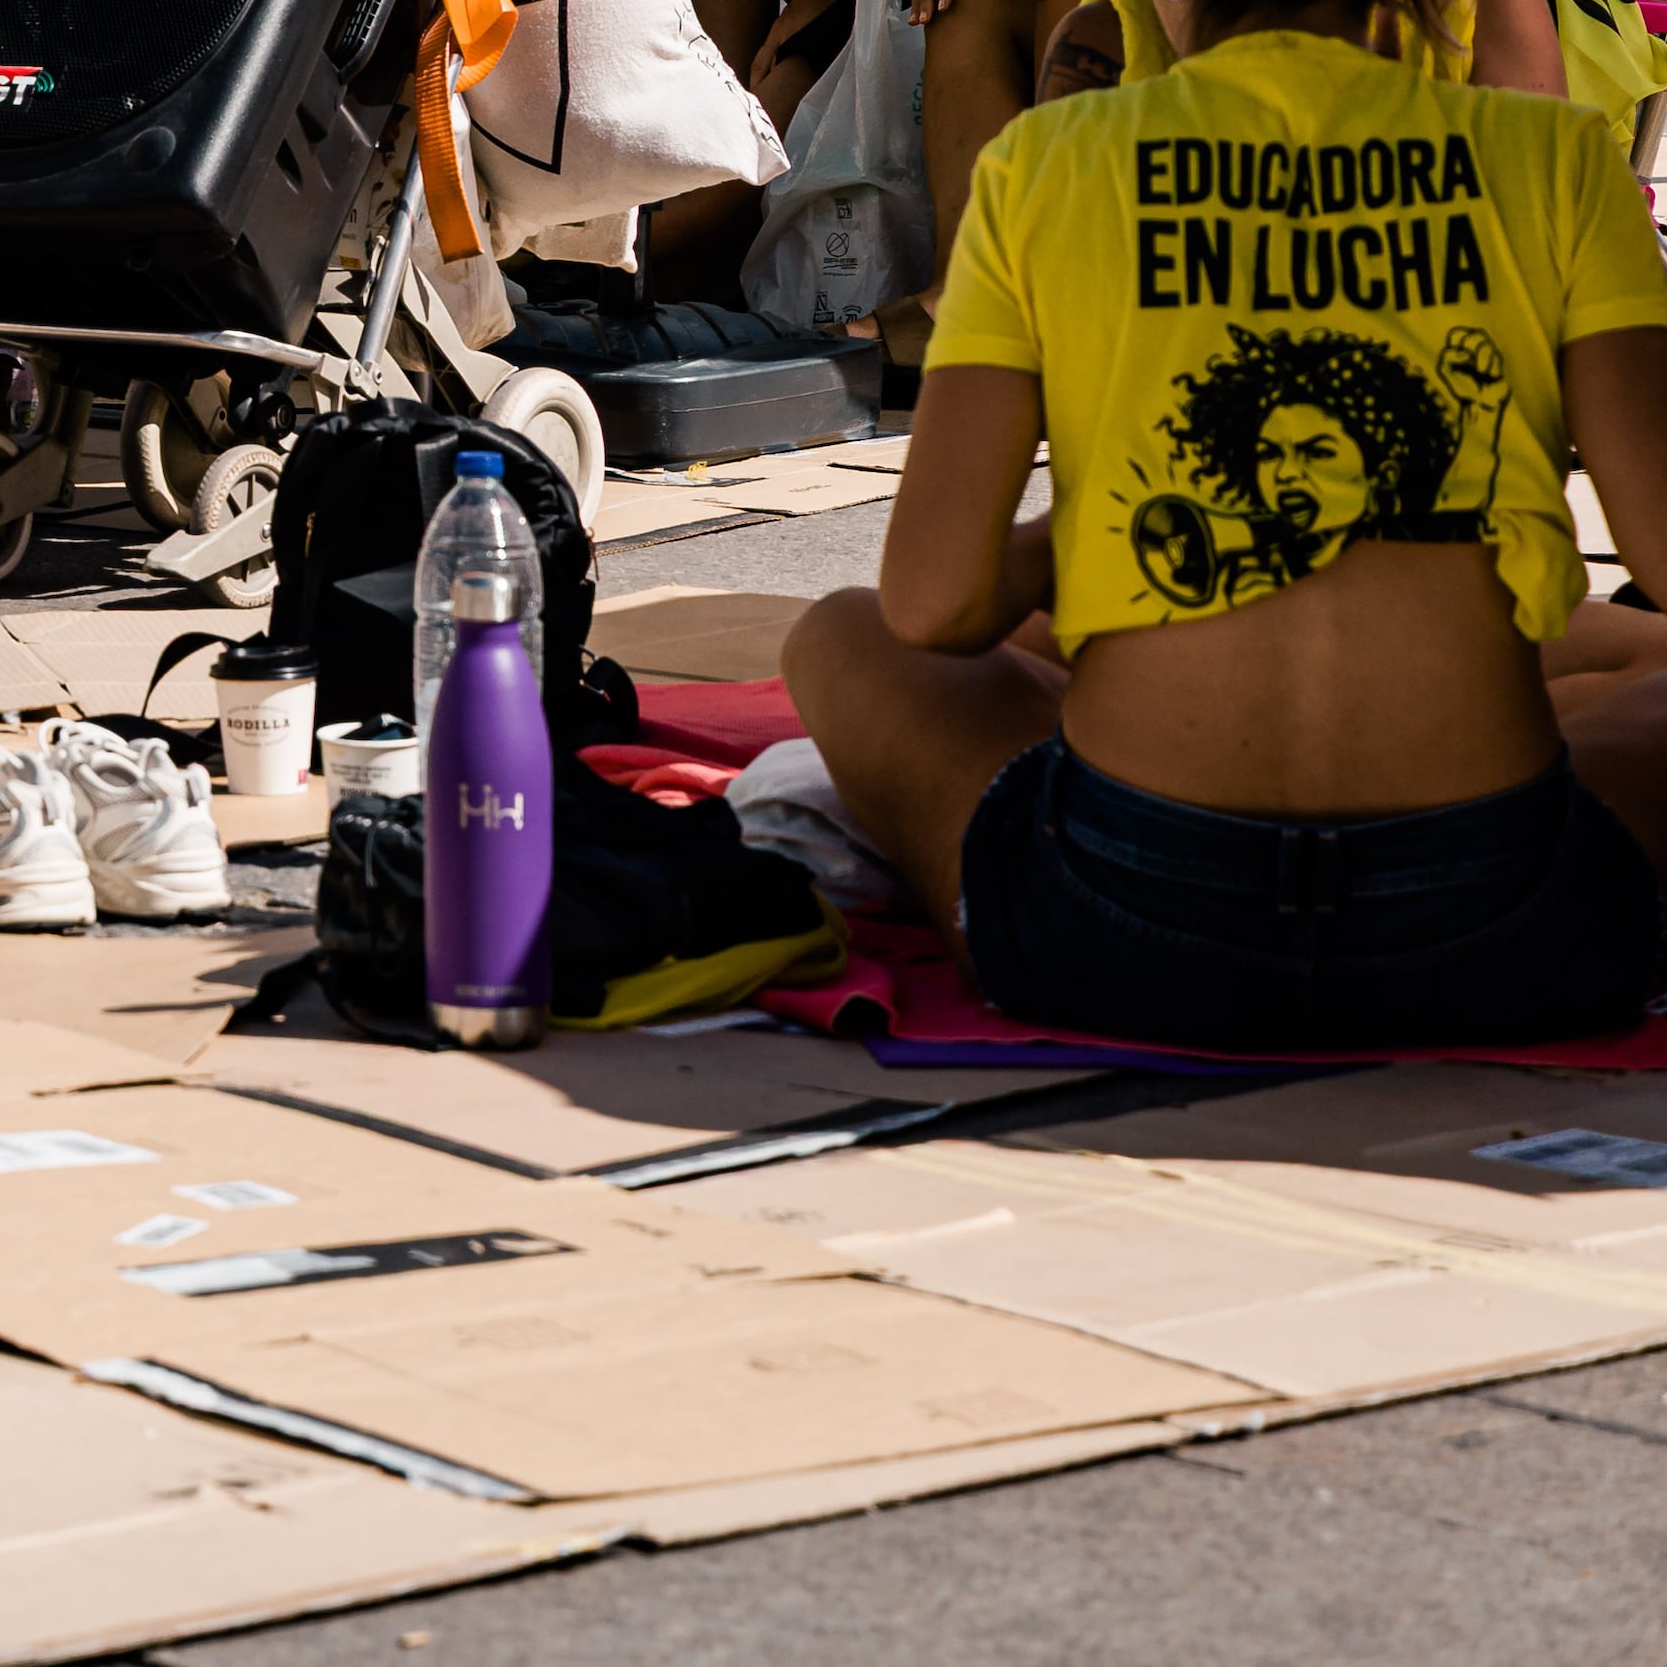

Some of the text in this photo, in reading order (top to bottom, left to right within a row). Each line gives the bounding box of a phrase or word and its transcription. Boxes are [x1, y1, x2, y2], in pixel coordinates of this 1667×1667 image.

[1136, 134, 1482, 219] EDUCADORA
[1138, 212, 1490, 312] EN LUCHA
[226, 717, 291, 731] RODILLA
